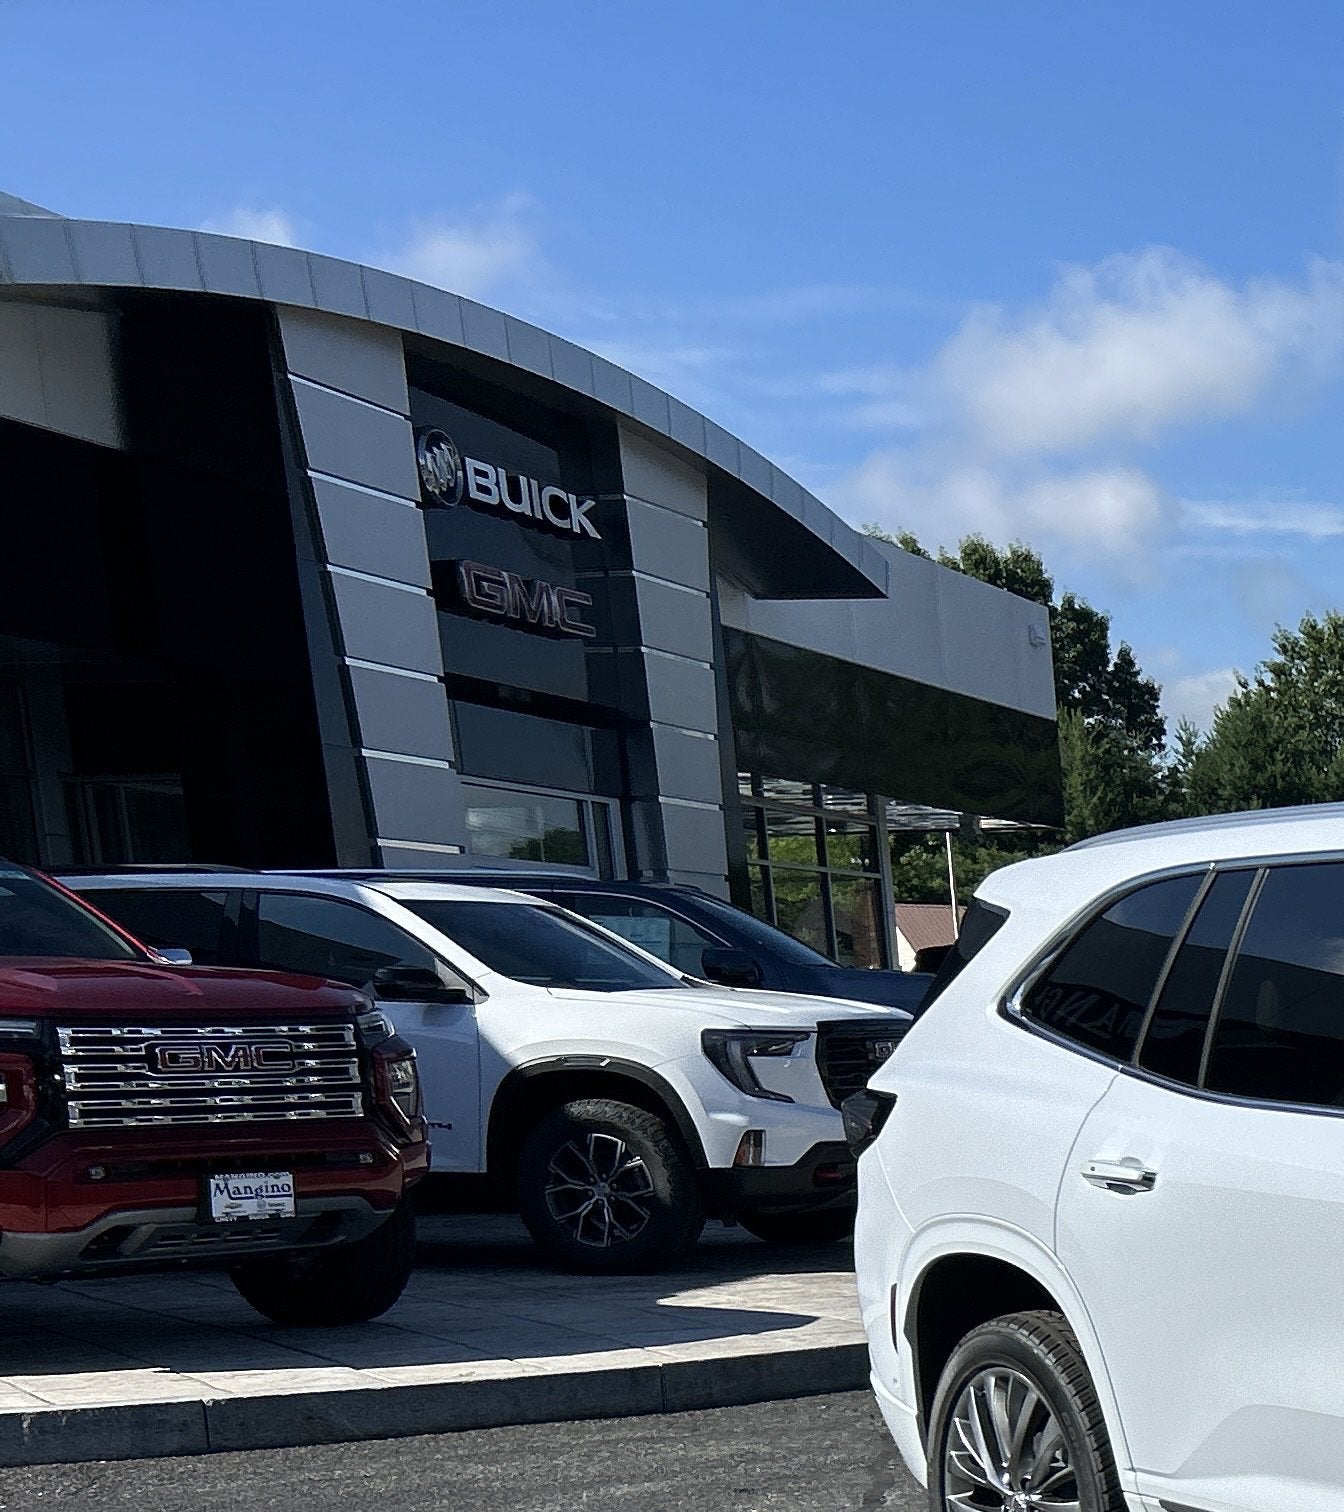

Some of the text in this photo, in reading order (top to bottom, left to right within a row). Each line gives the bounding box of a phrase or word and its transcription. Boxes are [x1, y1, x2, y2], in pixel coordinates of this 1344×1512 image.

[464, 456, 602, 539] BUICK
[460, 559, 597, 638] GMC
[156, 1044, 293, 1071] GMC
[213, 1181, 292, 1200] Mangino
